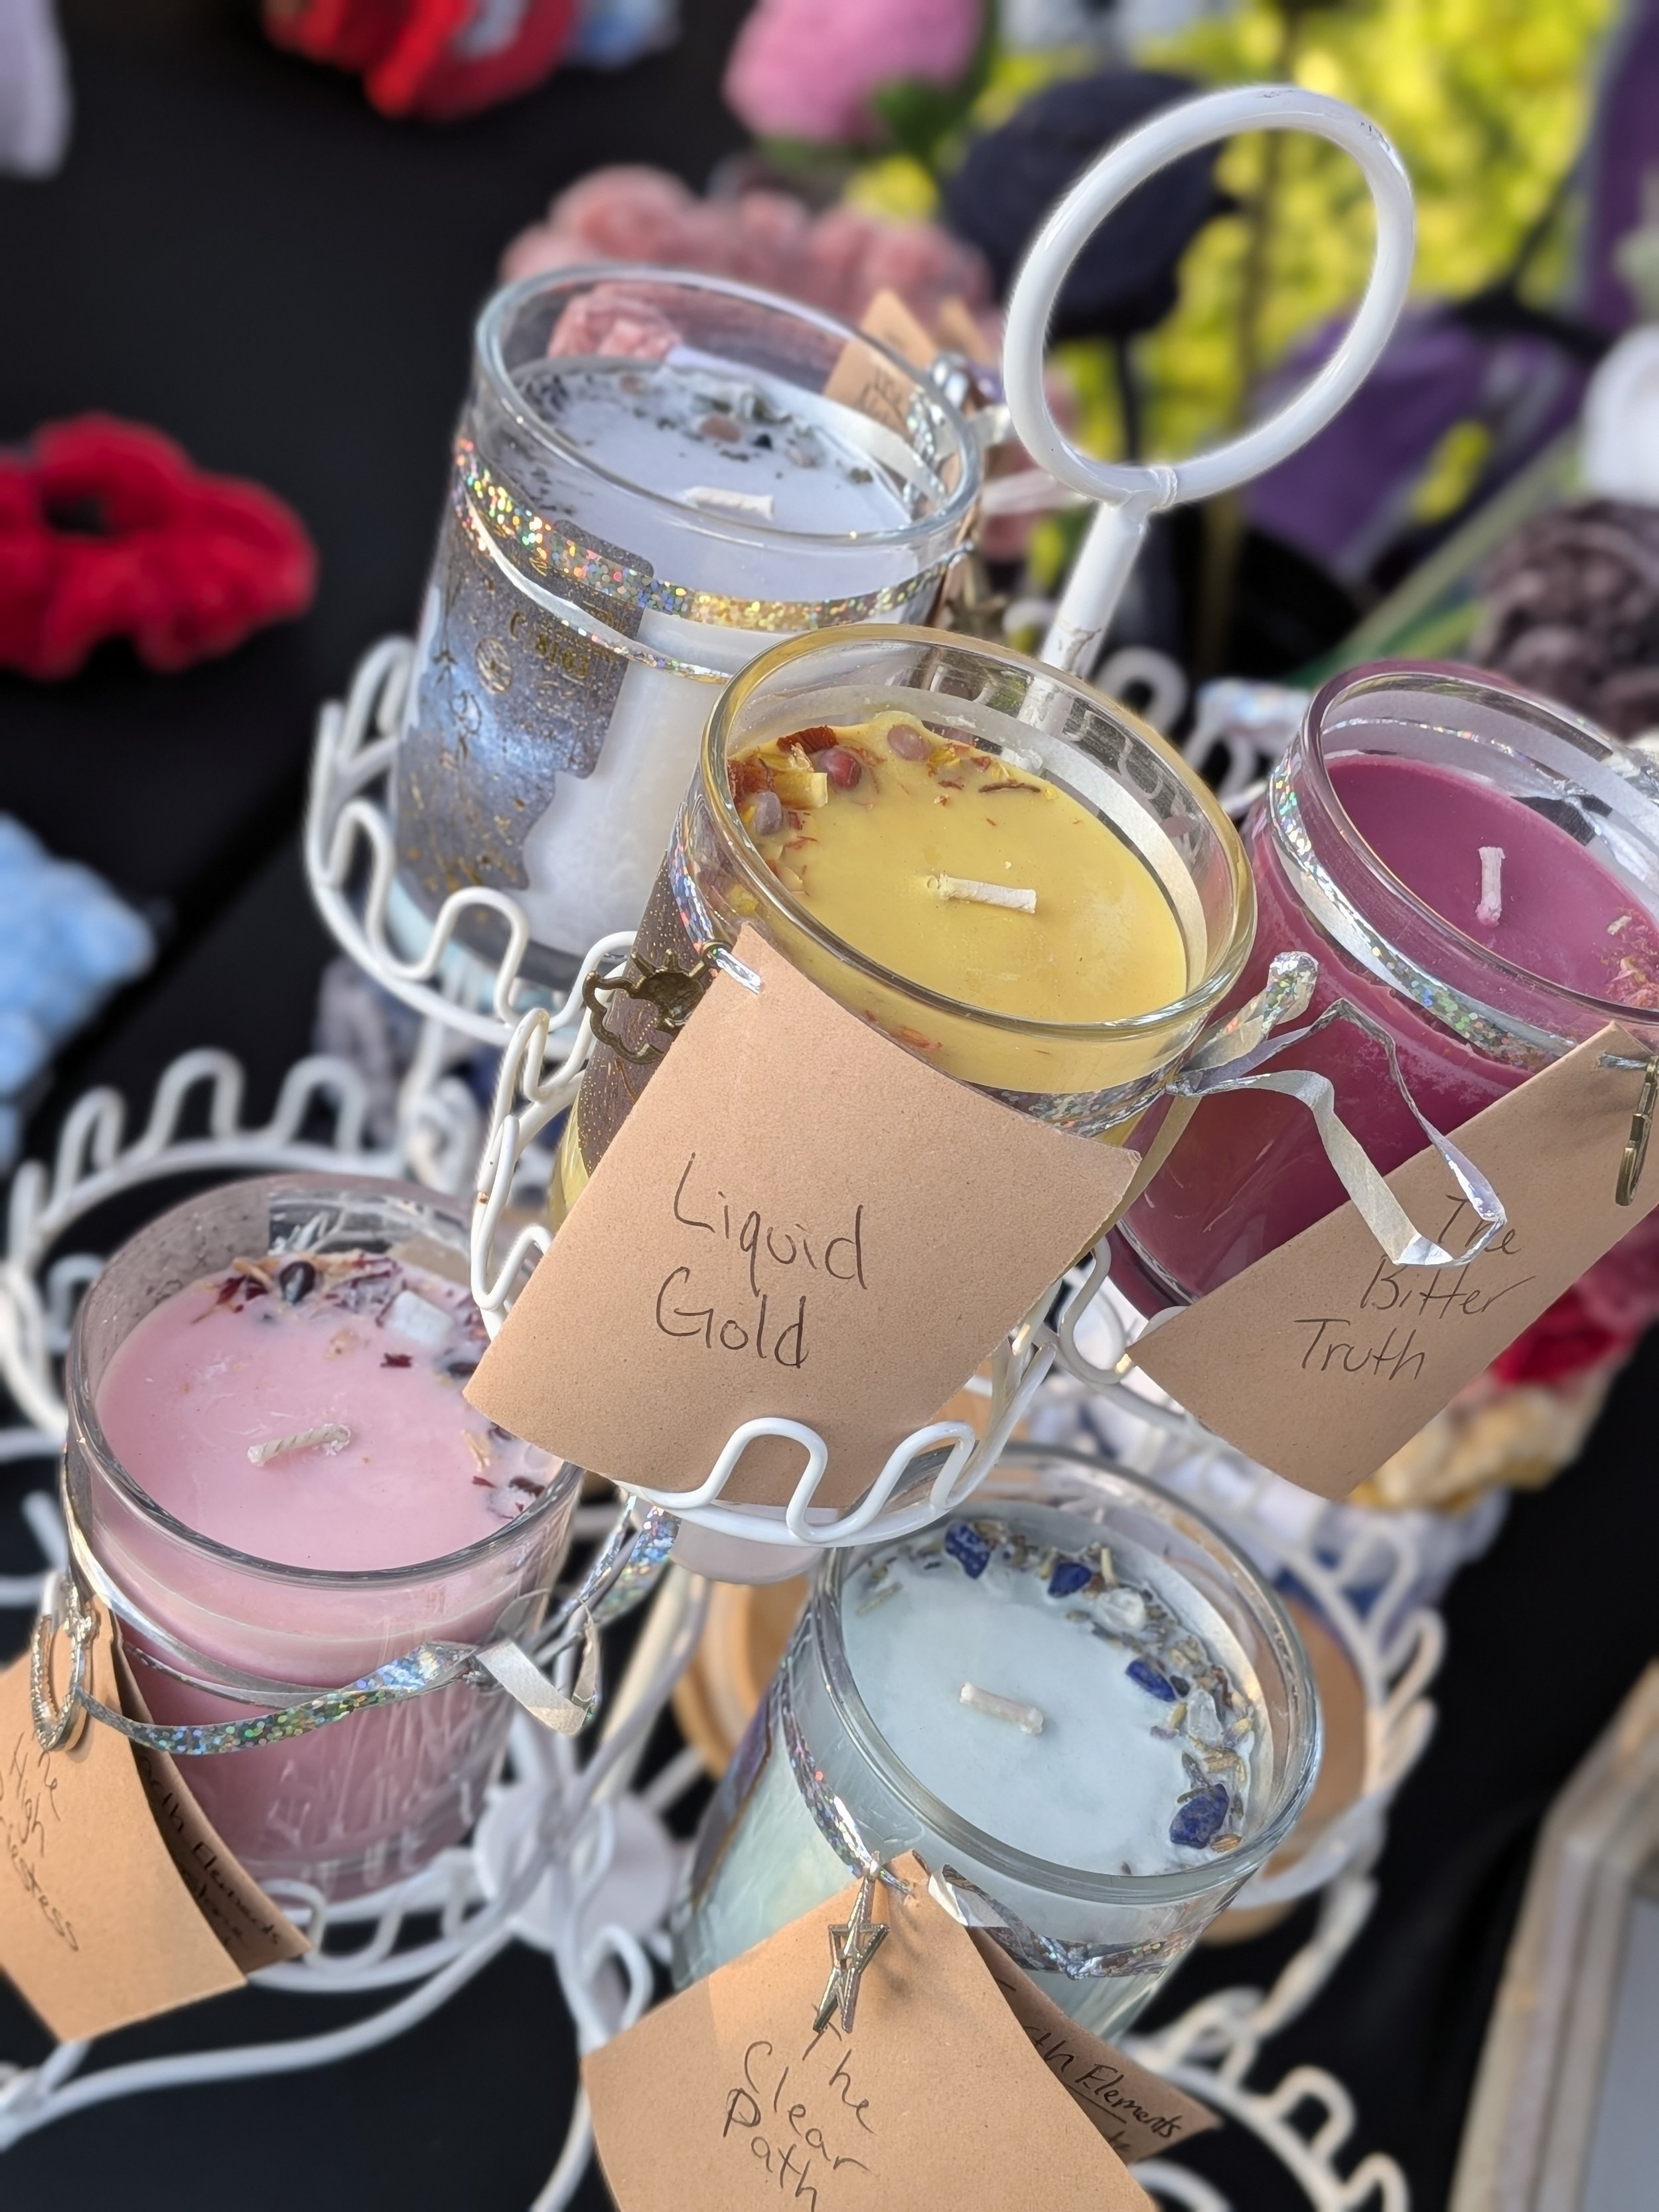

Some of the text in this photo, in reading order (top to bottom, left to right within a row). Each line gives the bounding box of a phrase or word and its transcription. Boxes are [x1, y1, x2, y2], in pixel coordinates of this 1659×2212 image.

[673, 1151, 867, 1297] Liquid
[655, 1266, 810, 1369] Gold
[1360, 1254, 1536, 1319] Bitter
[1294, 1317, 1426, 1381] Truth
[743, 2040, 872, 2173] Clear
[1074, 2063, 1183, 2138] Elements
